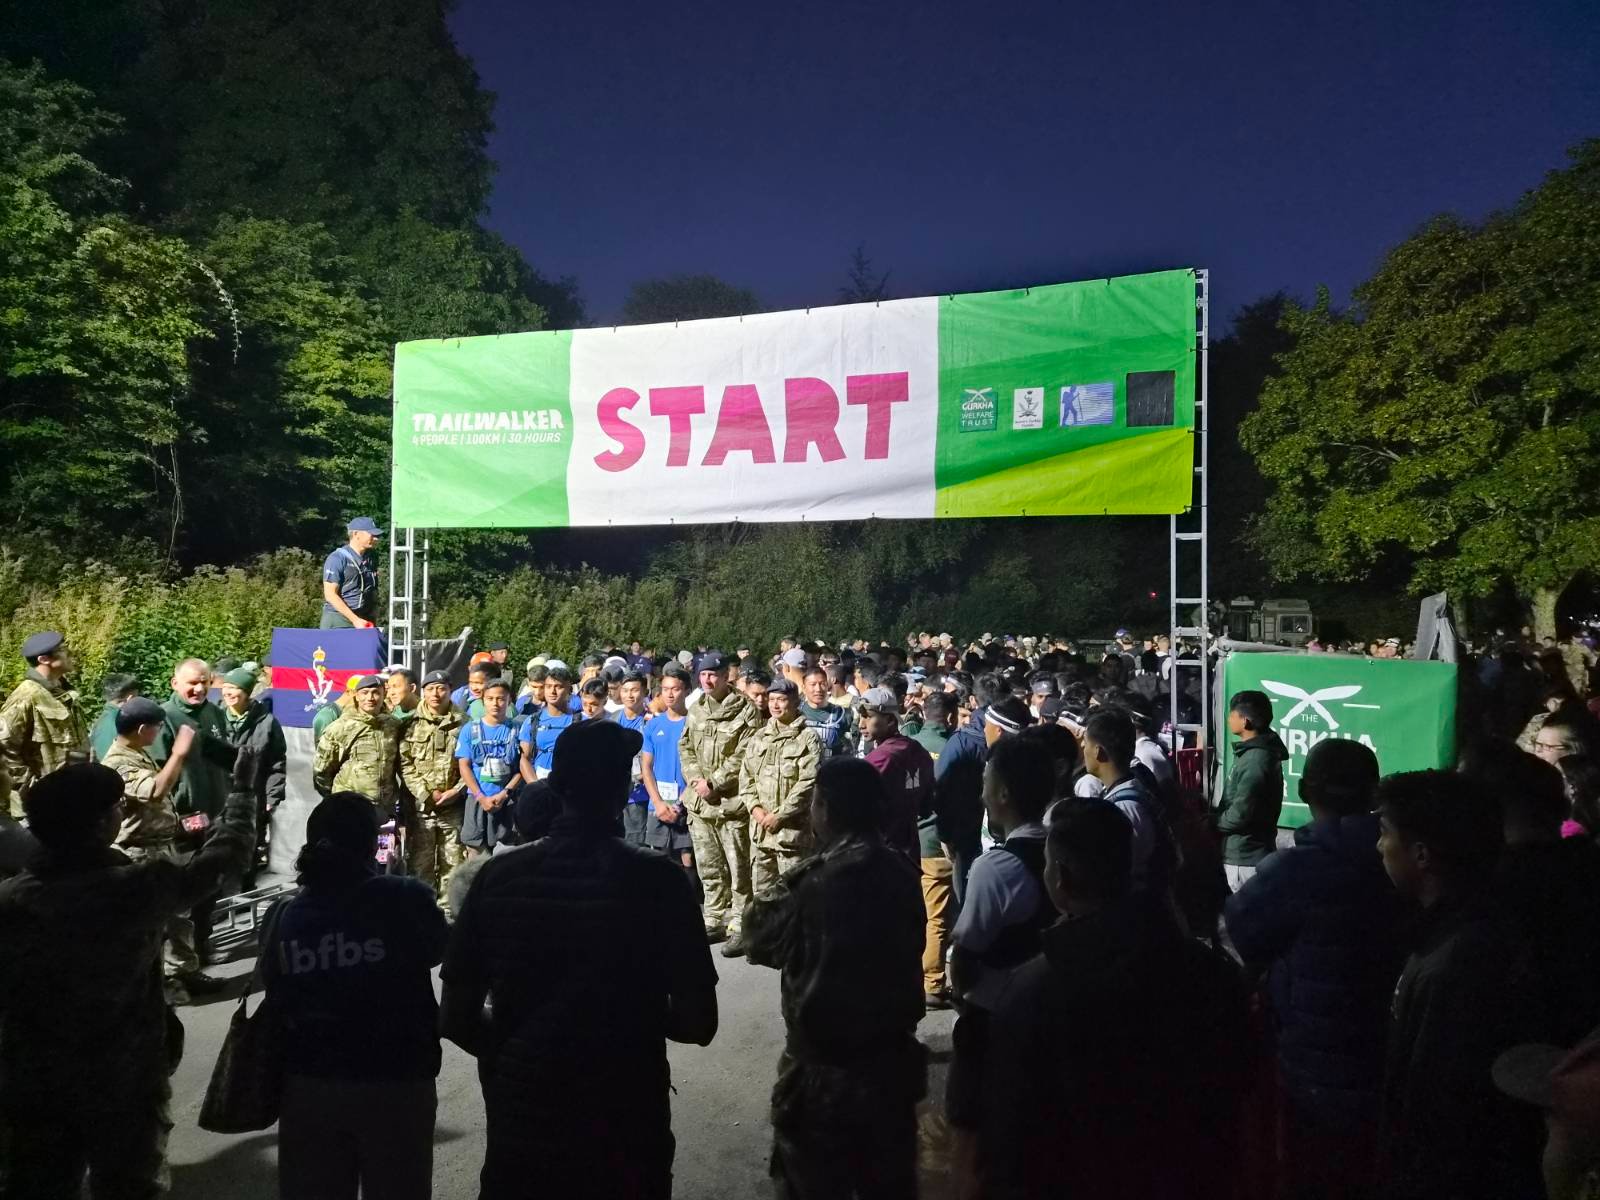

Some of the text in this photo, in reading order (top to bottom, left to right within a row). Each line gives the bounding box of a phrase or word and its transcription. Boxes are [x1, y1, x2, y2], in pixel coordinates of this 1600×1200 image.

[962, 401, 994, 411] GURKHA
[412, 409, 564, 432] TRAILWALKER
[961, 411, 994, 419] WELFARE
[593, 371, 909, 472] START
[961, 418, 993, 427] TRUST
[412, 434, 419, 446] 4
[420, 433, 458, 446] PEOPLE
[466, 432, 500, 445] 100KM
[508, 432, 522, 444] 30
[525, 431, 561, 444] HOURS
[1300, 713, 1319, 723] THE
[289, 931, 386, 974] bfbs
